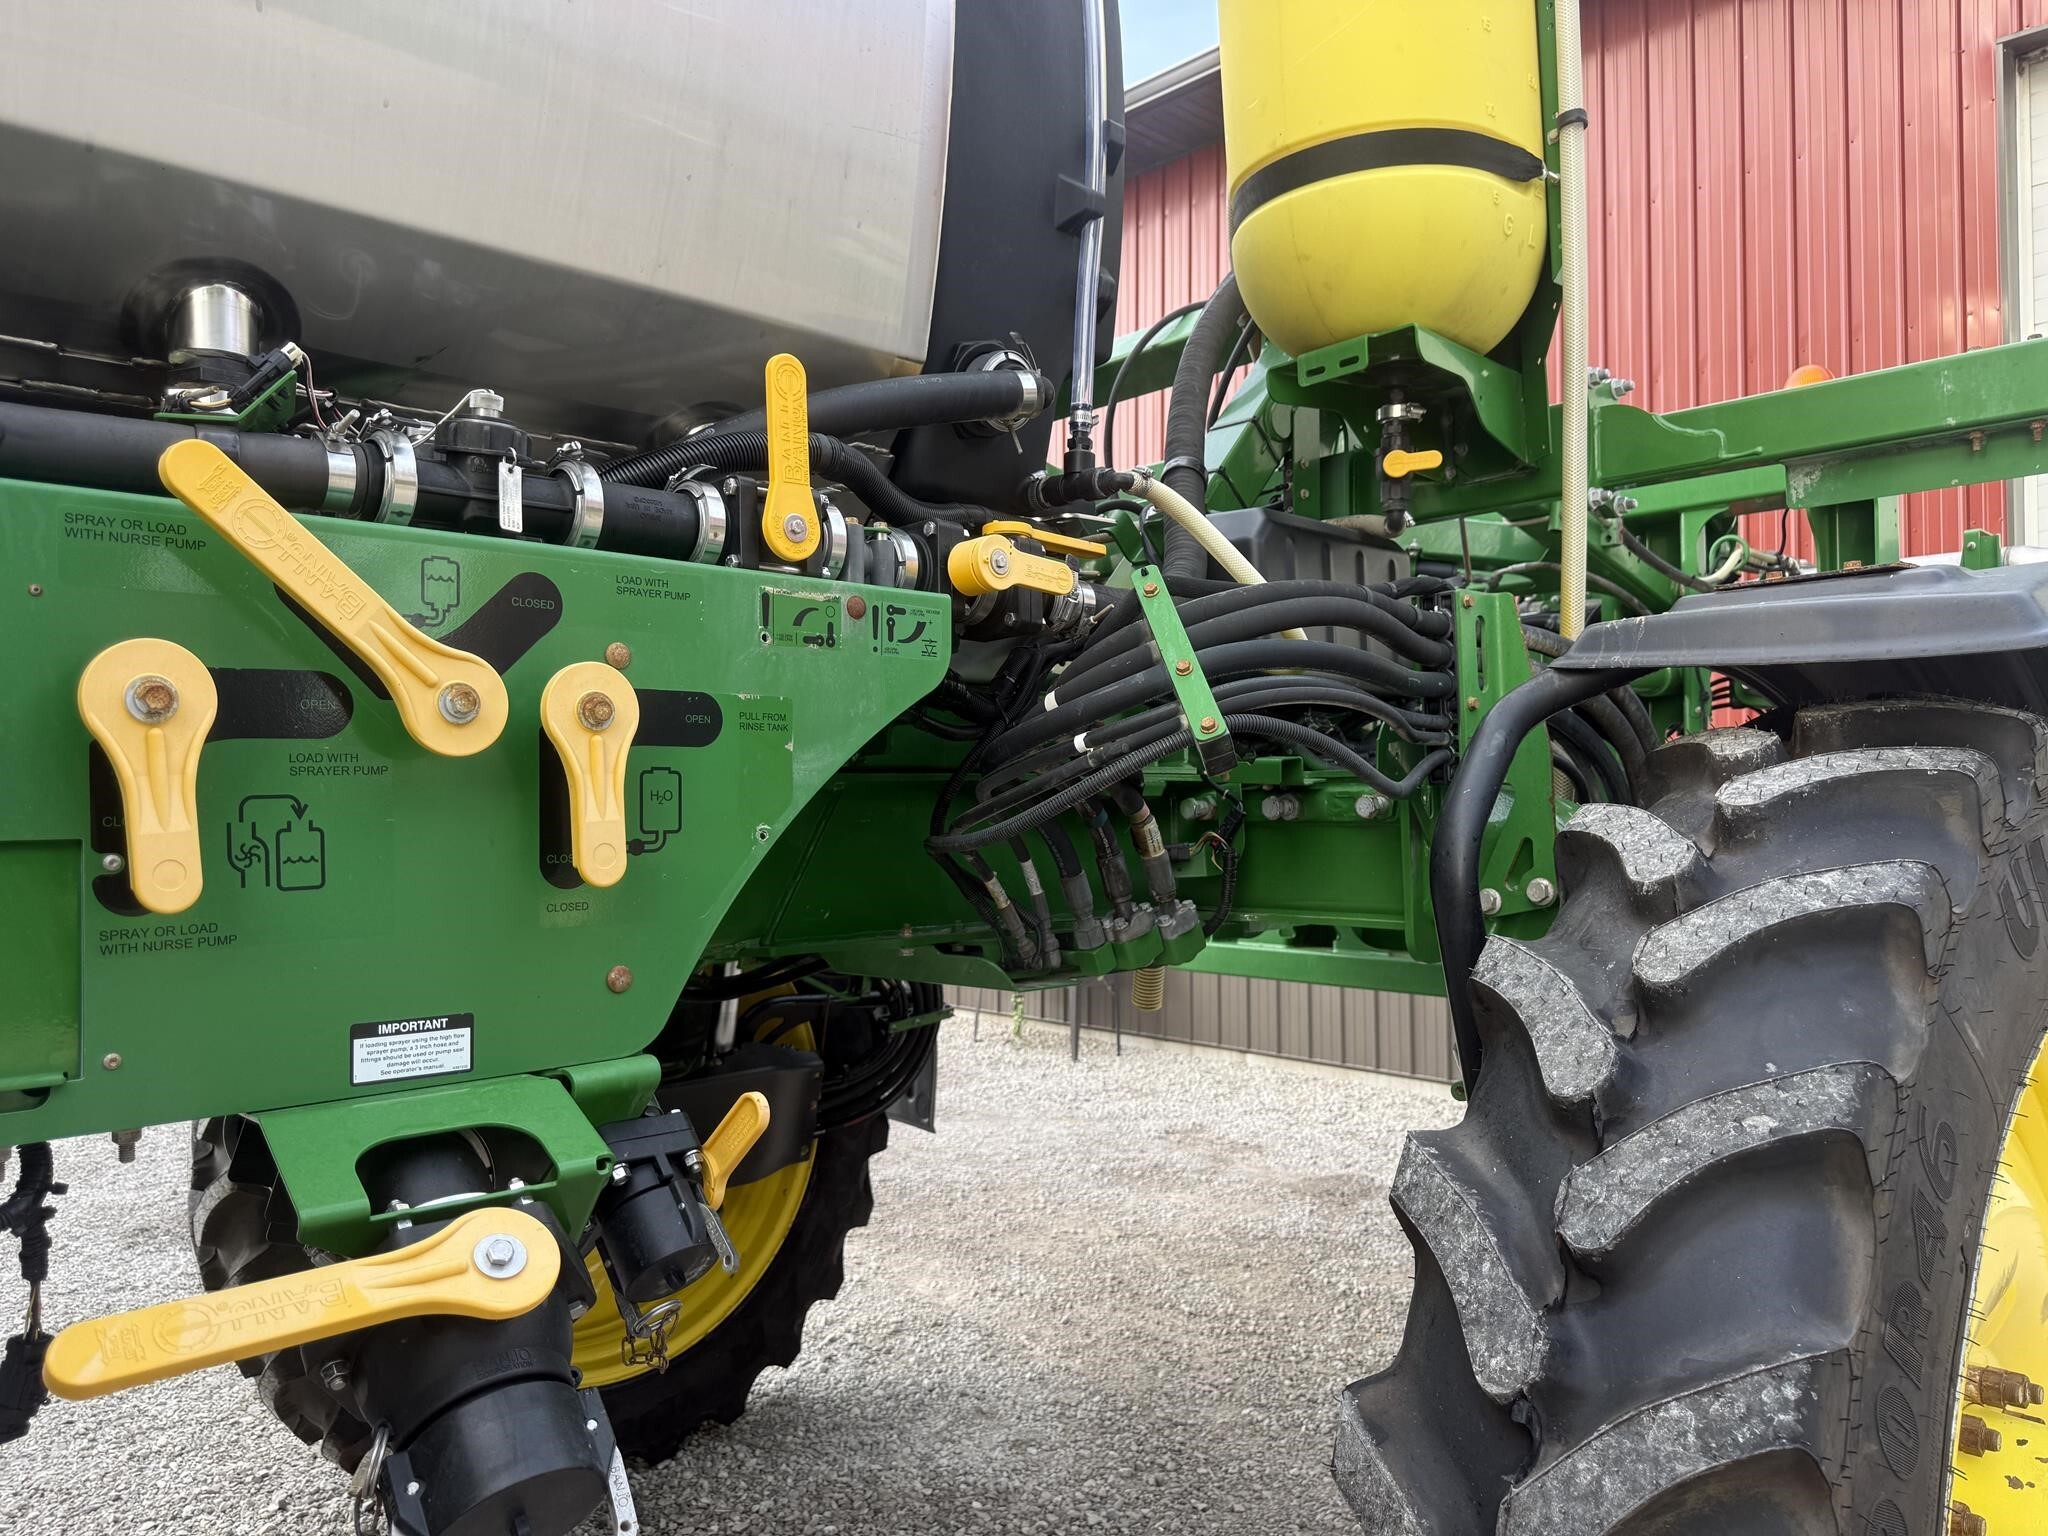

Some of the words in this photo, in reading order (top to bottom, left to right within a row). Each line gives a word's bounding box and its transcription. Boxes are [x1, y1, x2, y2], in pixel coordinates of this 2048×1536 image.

[64, 512, 117, 528] SPRAY
[121, 518, 143, 532] OR
[147, 521, 187, 536] LOAD
[64, 526, 104, 541] WITH
[108, 531, 161, 547] NURSE
[165, 536, 207, 551] PUMP
[615, 574, 643, 586] LOAD
[644, 578, 669, 589] WITH
[615, 586, 663, 600] SPRAYER
[664, 590, 691, 601] PUMP
[511, 596, 555, 610] CLOSED
[300, 699, 336, 711] OPEN
[685, 714, 711, 724] OPEN
[739, 711, 760, 721] PULL
[762, 712, 787, 722] FROM
[739, 722, 765, 732] RINSE
[766, 723, 789, 733] TANK
[288, 752, 324, 764] LOAD
[326, 752, 359, 763] WITH
[289, 765, 350, 777] SPRAYER
[353, 764, 389, 776] PUMP
[546, 854, 574, 864] CLOS
[546, 901, 589, 913] CLOSED
[99, 927, 149, 942] SPRAY
[154, 925, 176, 937] OR
[180, 922, 219, 935] LOAD
[99, 942, 139, 956] WITH
[142, 937, 194, 952] NURSE
[197, 934, 238, 949] PUMP
[378, 1017, 449, 1035] IMPORTANT
[365, 1040, 388, 1048] loading
[366, 1048, 389, 1056] sprayer
[360, 1056, 382, 1064] fittings
[609, 1465, 629, 1508] BANJO
